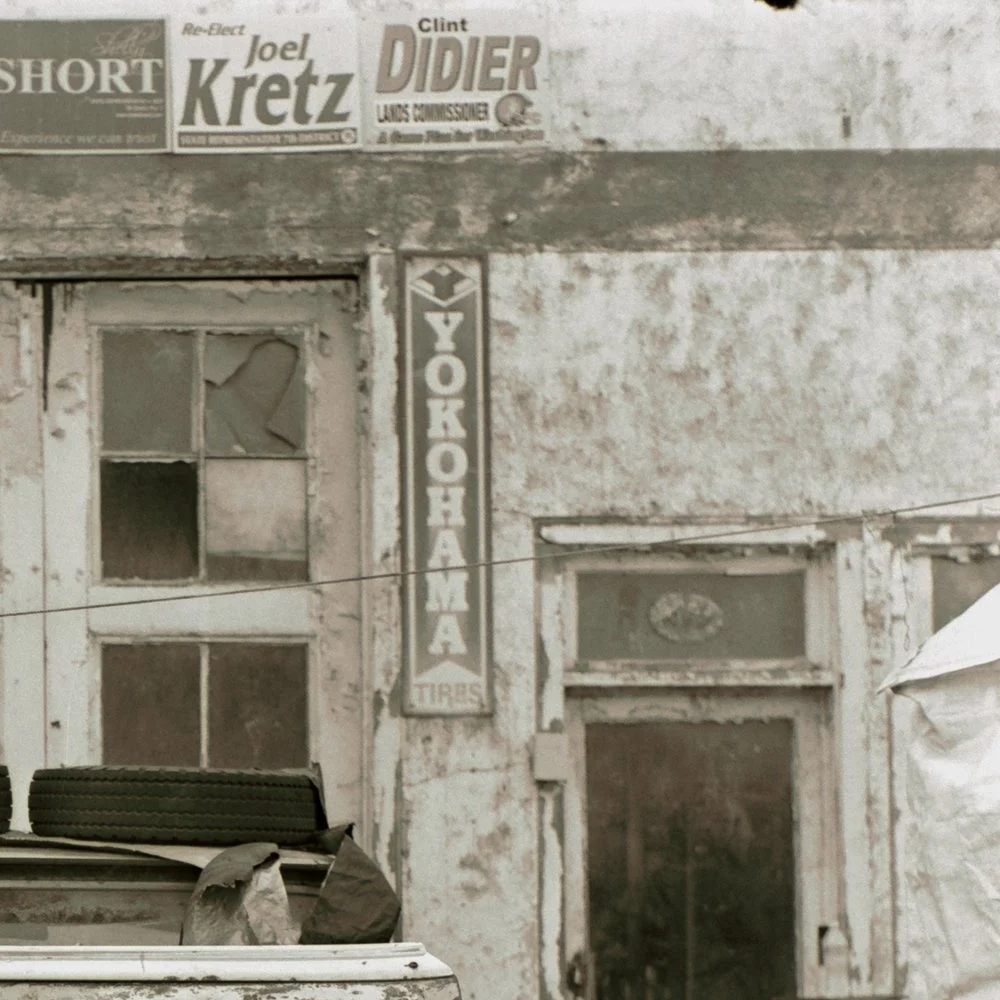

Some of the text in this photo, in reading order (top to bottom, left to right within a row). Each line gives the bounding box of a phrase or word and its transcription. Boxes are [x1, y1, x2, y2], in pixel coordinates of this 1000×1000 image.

[181, 22, 247, 37] Re-Elect
[418, 17, 469, 33] Clint
[243, 32, 311, 70] Joel
[375, 23, 542, 94] DIDIER
[179, 58, 356, 127] Kretz
[423, 311, 469, 656] YOKOHAMA
[413, 683, 483, 706] TIRES
